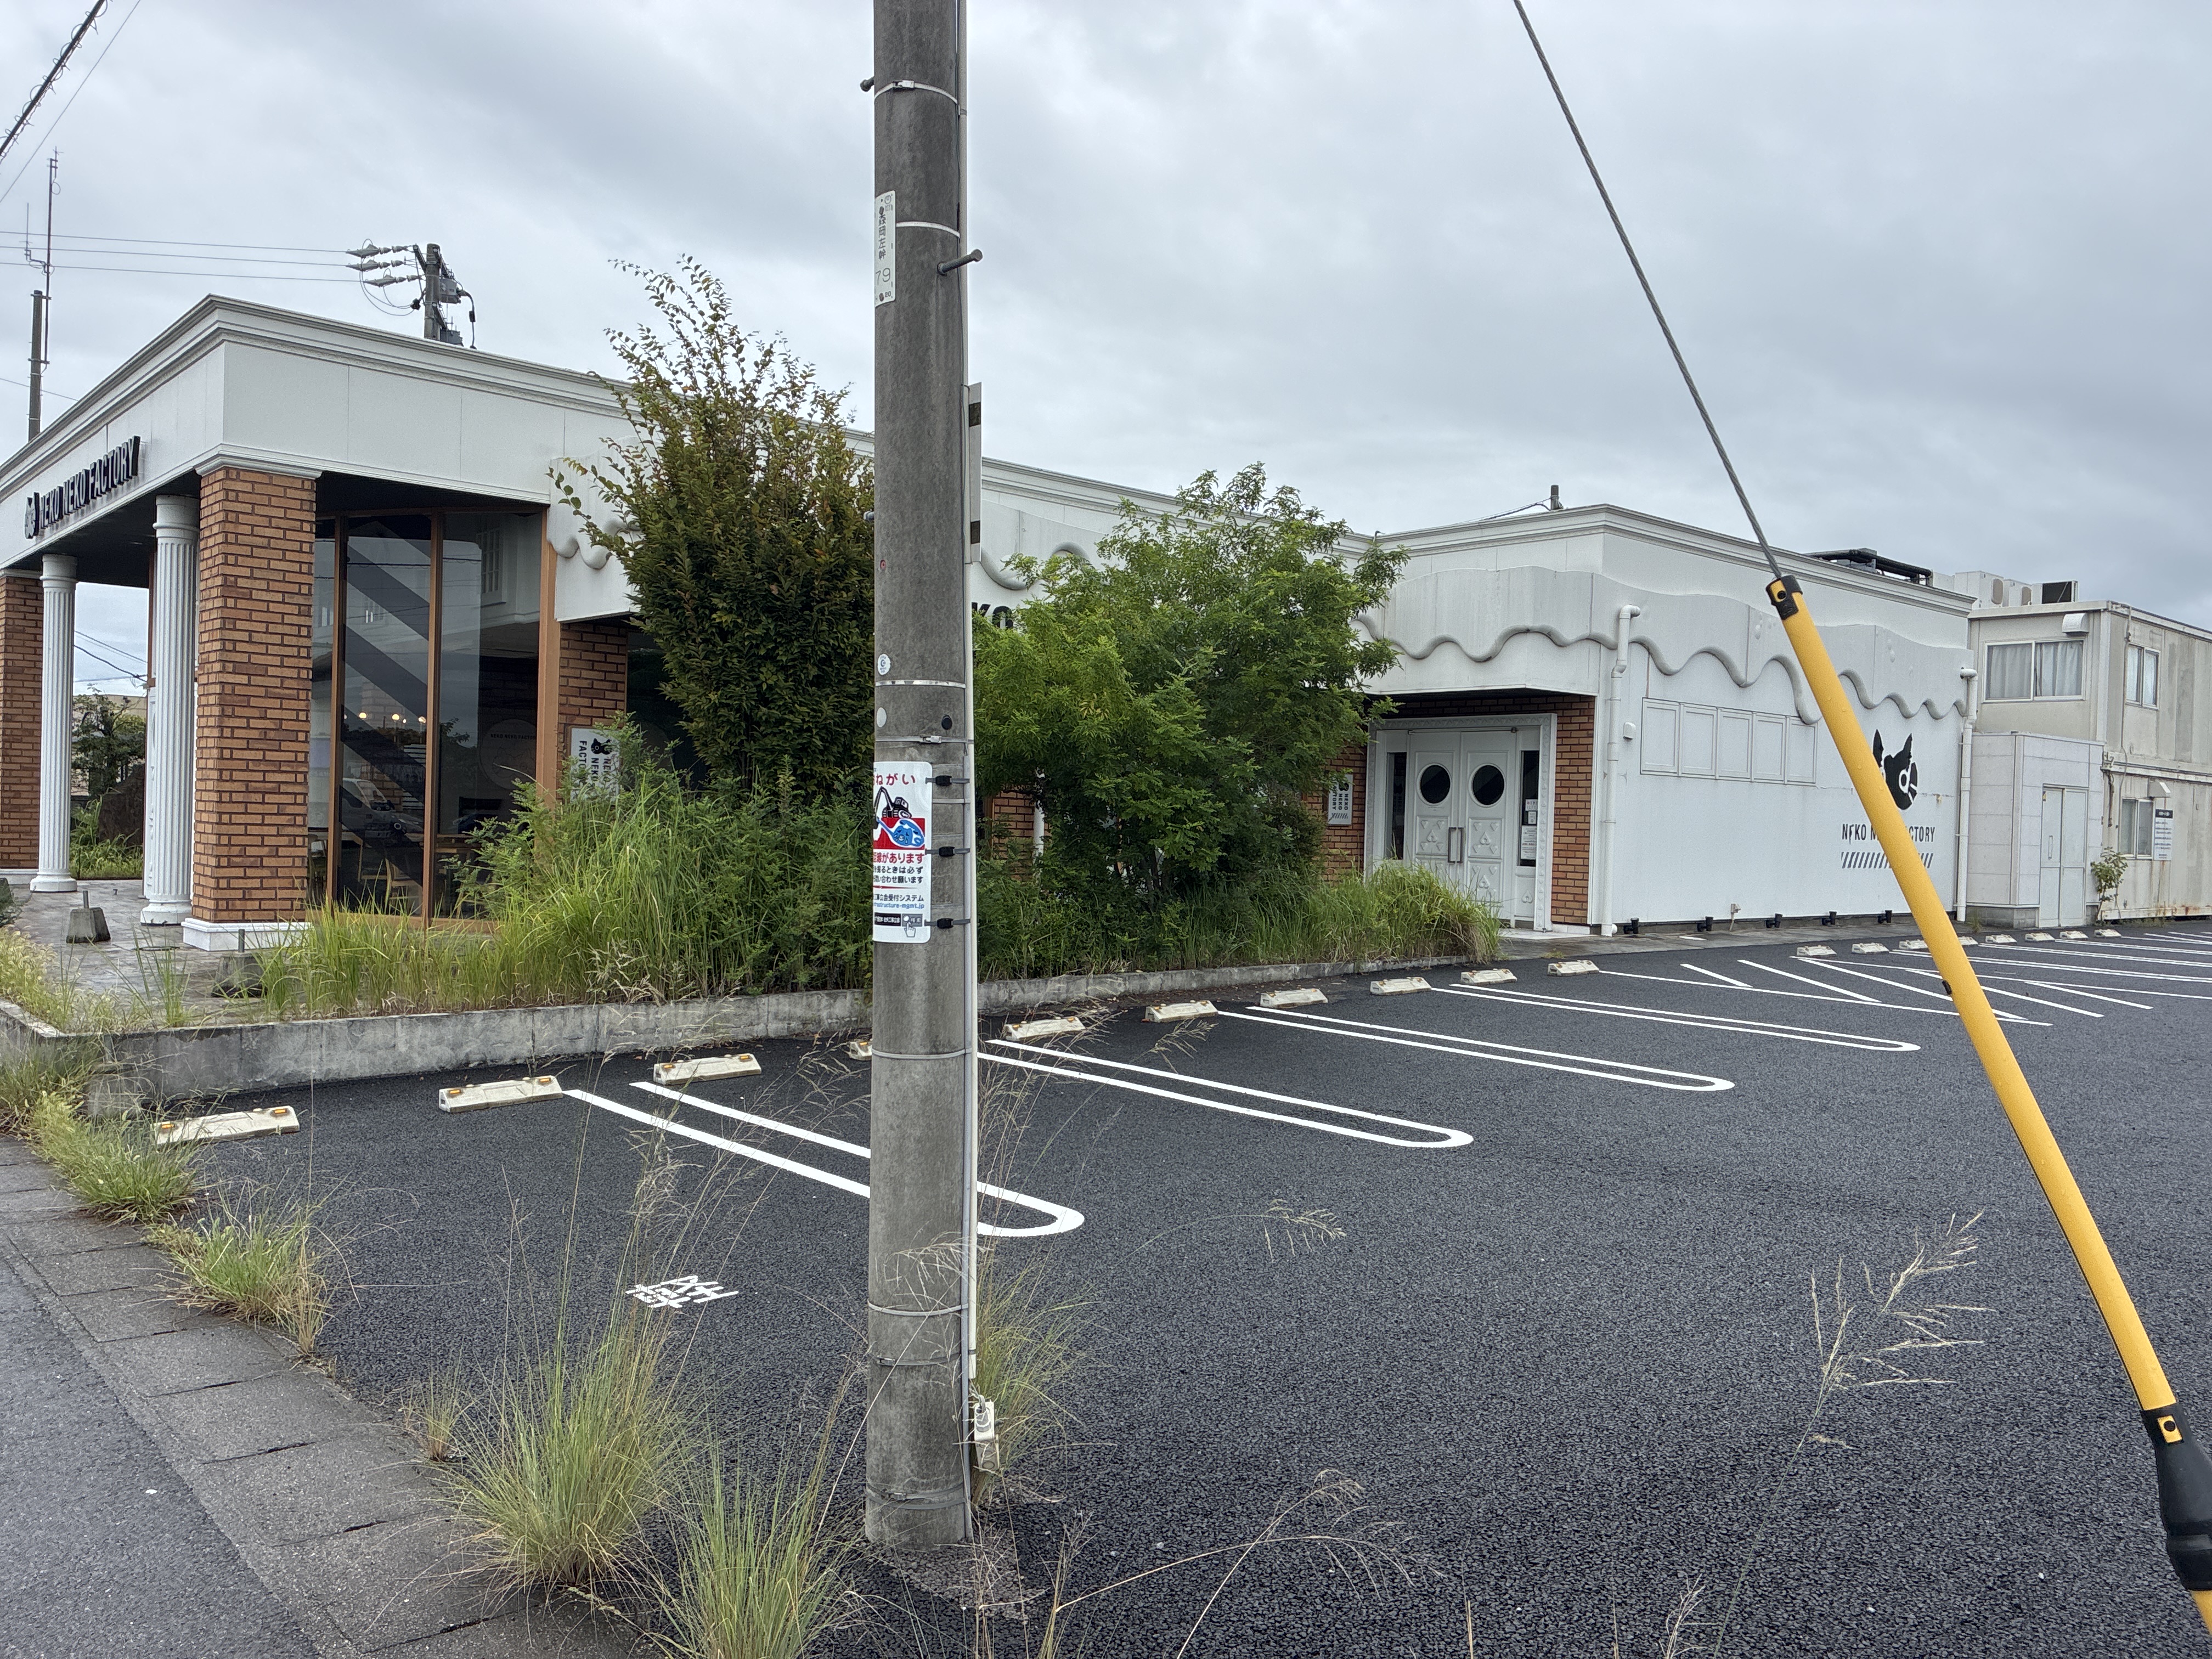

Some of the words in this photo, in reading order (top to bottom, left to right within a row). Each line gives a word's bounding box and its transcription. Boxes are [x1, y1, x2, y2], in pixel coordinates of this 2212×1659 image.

[876, 267, 891, 286] 79
[40, 486, 64, 529] NEKO
[63, 468, 90, 516] NEKO
[89, 436, 140, 500] FACTORY
[873, 772, 915, 786] ねがい
[625, 1274, 739, 1308] 軽
